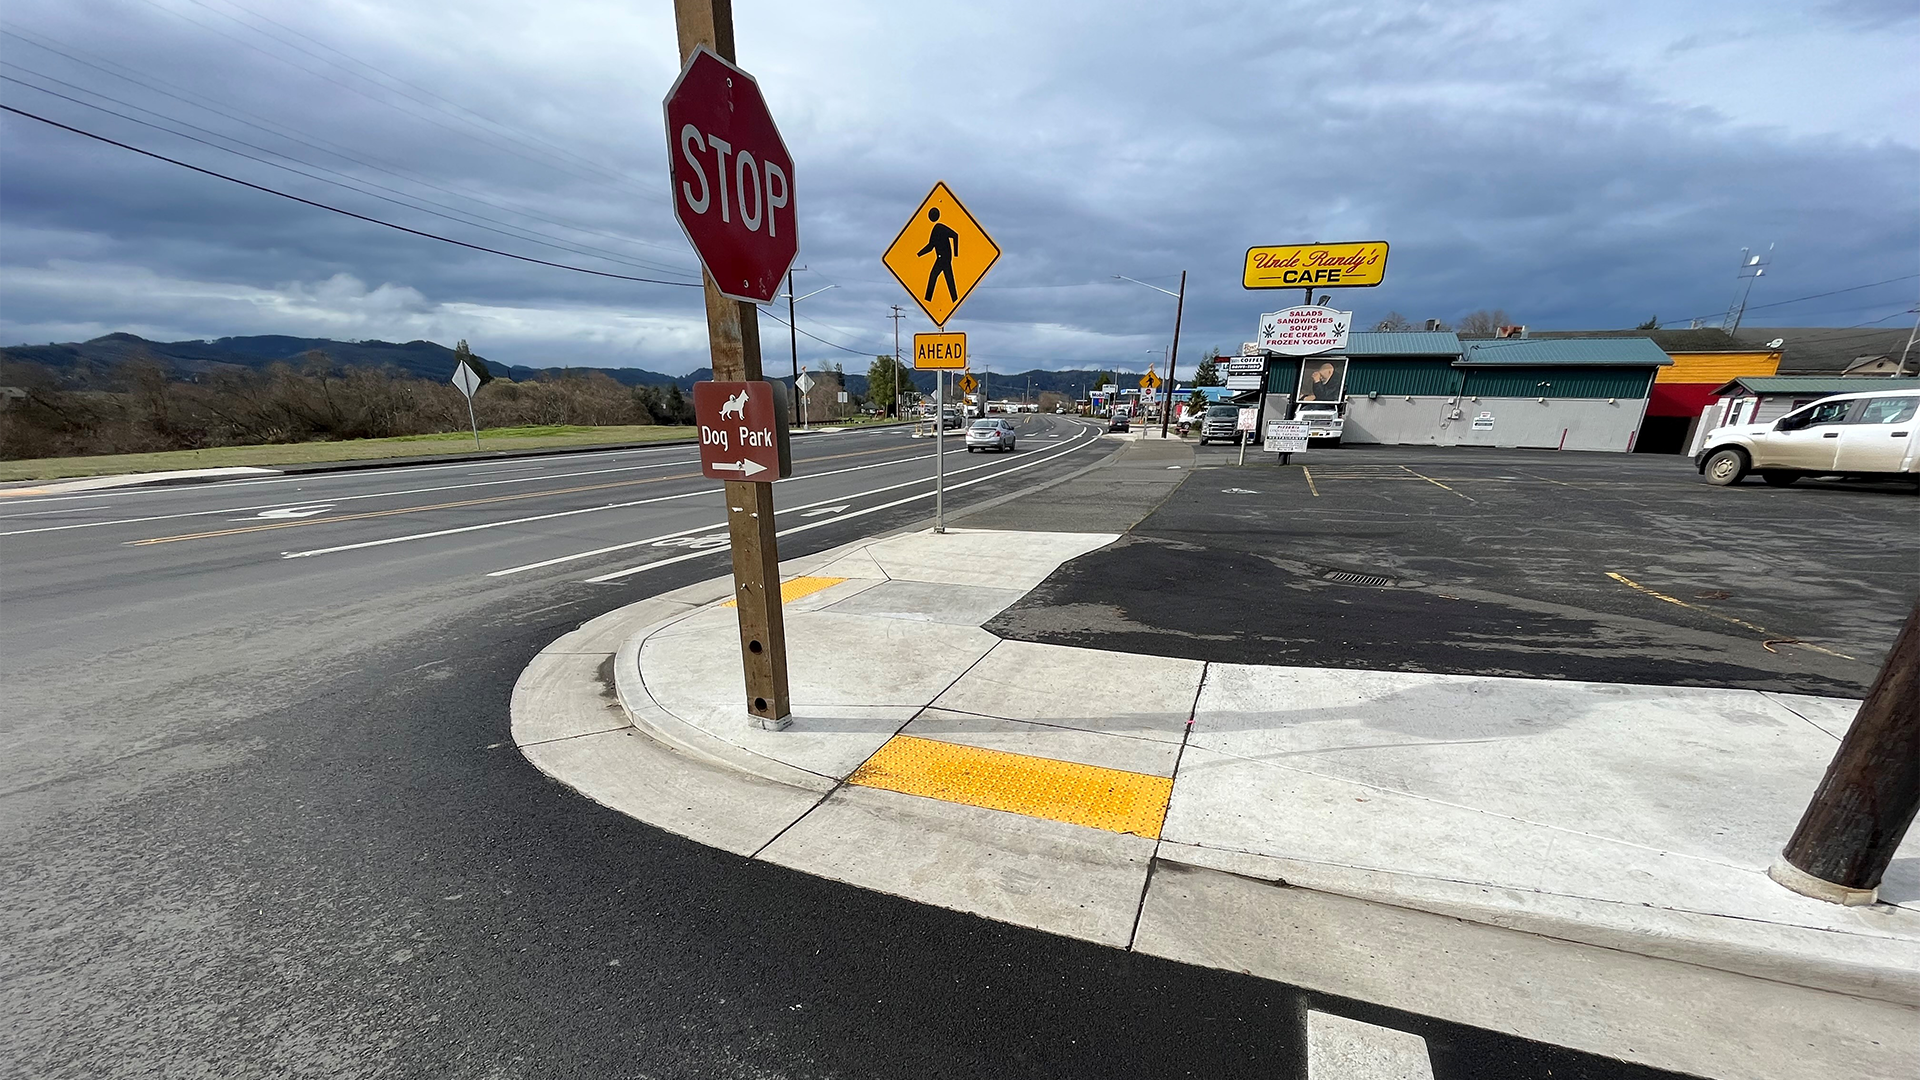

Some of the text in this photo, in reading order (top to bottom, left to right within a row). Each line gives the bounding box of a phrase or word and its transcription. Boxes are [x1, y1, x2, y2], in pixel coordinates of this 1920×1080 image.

[681, 123, 788, 237] STOP
[1253, 247, 1380, 274] Uncle Randy's
[1283, 269, 1342, 284] CAFE
[918, 343, 962, 359] AHEAD
[701, 425, 773, 452] Dog Park
